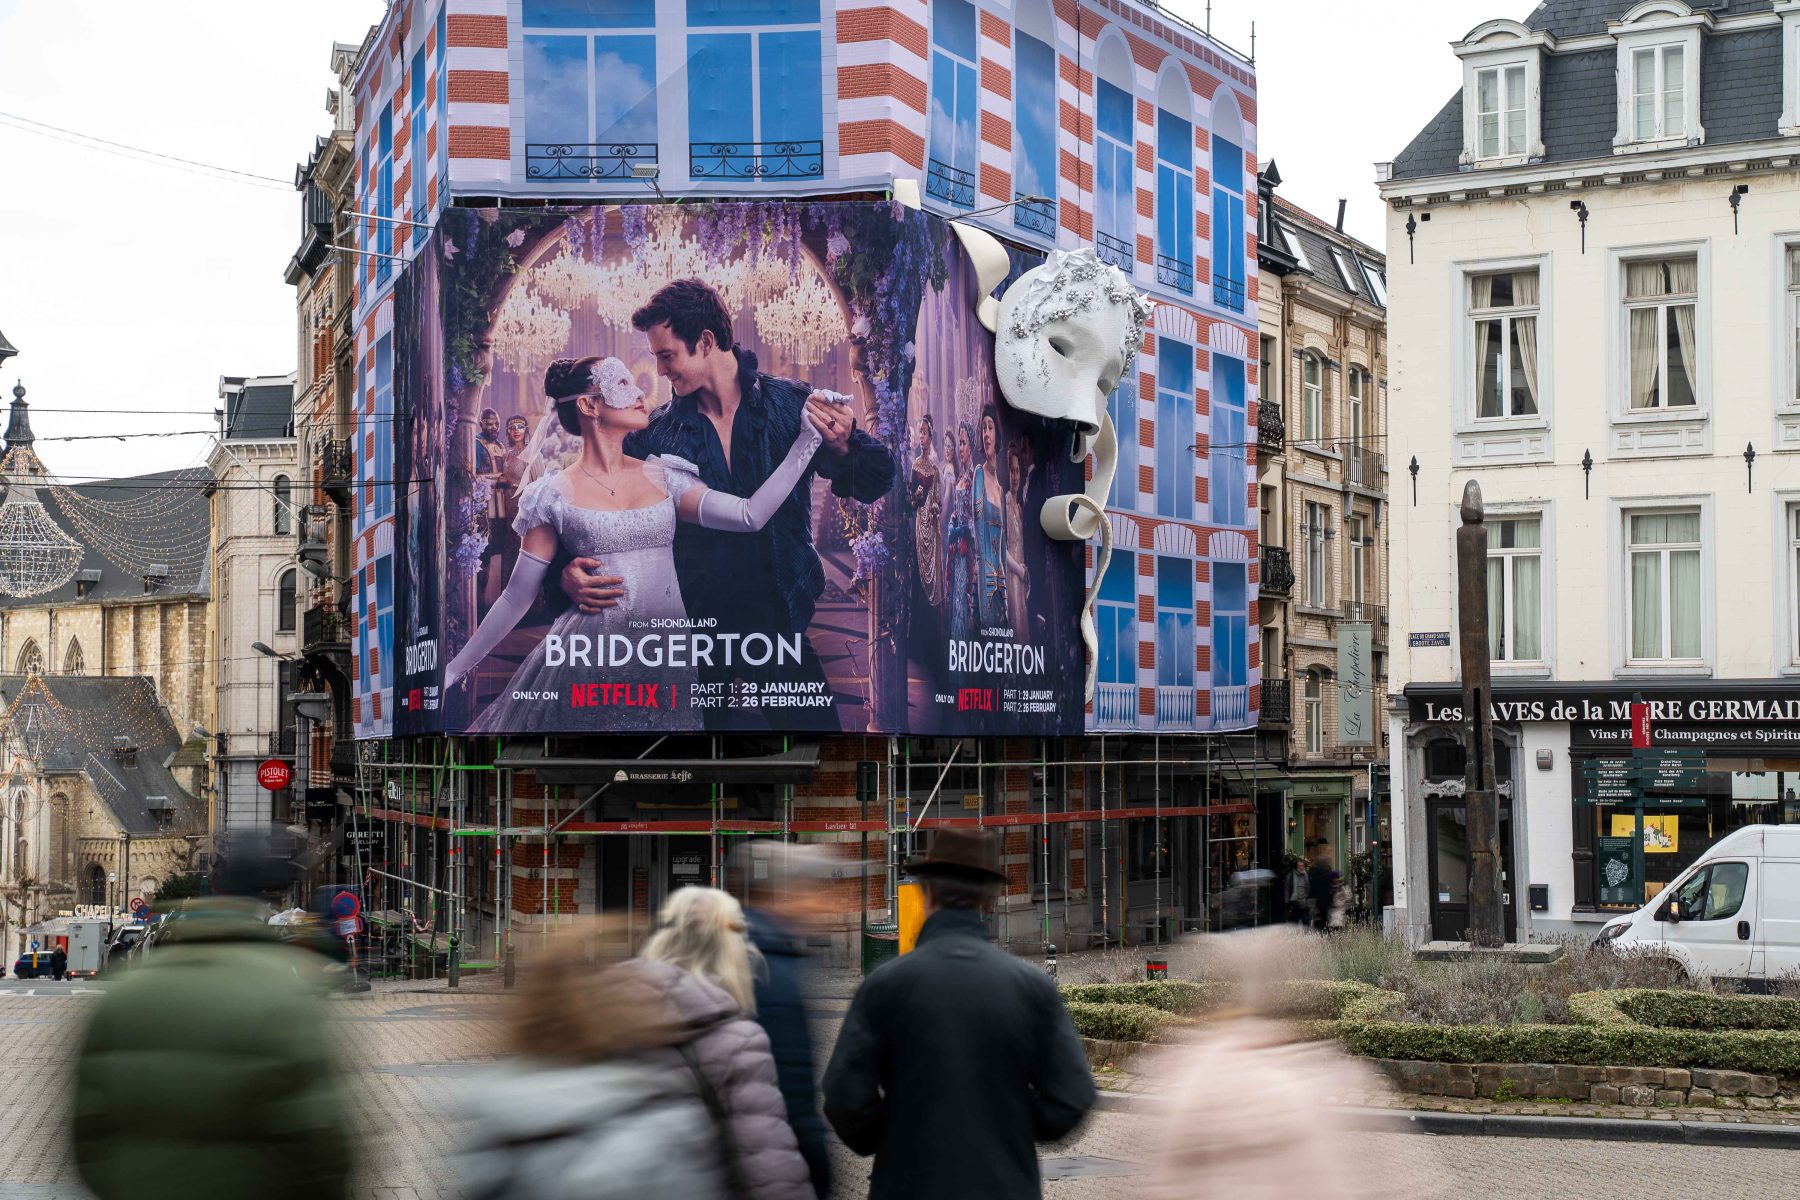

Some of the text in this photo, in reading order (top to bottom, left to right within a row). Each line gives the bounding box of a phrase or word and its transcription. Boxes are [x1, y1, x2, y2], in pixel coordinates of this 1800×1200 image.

[628, 617, 718, 629] FROM SHONDALAND
[545, 632, 802, 667] BRIDGERTON
[405, 638, 438, 676] BRIDGERTON
[948, 639, 1045, 676] BRIDGERTON
[690, 682, 826, 695] PART 1: 29 JANUARY
[1003, 689, 1017, 700] PART
[1029, 690, 1054, 700] JANUARY
[512, 683, 659, 709] ONLY ON NETFLIX
[690, 695, 834, 708] PART 2: 26 FEBRUARY
[935, 693, 948, 703] ONLY
[958, 688, 993, 712] NETFLIX
[1003, 702, 1017, 712] PART
[1029, 702, 1057, 713] FEBRUARY
[1425, 699, 1800, 721] Les AVES de la MRE GERMAI
[1344, 712, 1362, 738] La
[1589, 728, 1618, 740] Vins
[1654, 728, 1737, 742] Champagnes
[1740, 730, 1753, 740] et
[260, 767, 289, 778] PISTOLET
[669, 769, 692, 782] Leffe
[672, 855, 702, 864] upgrade
